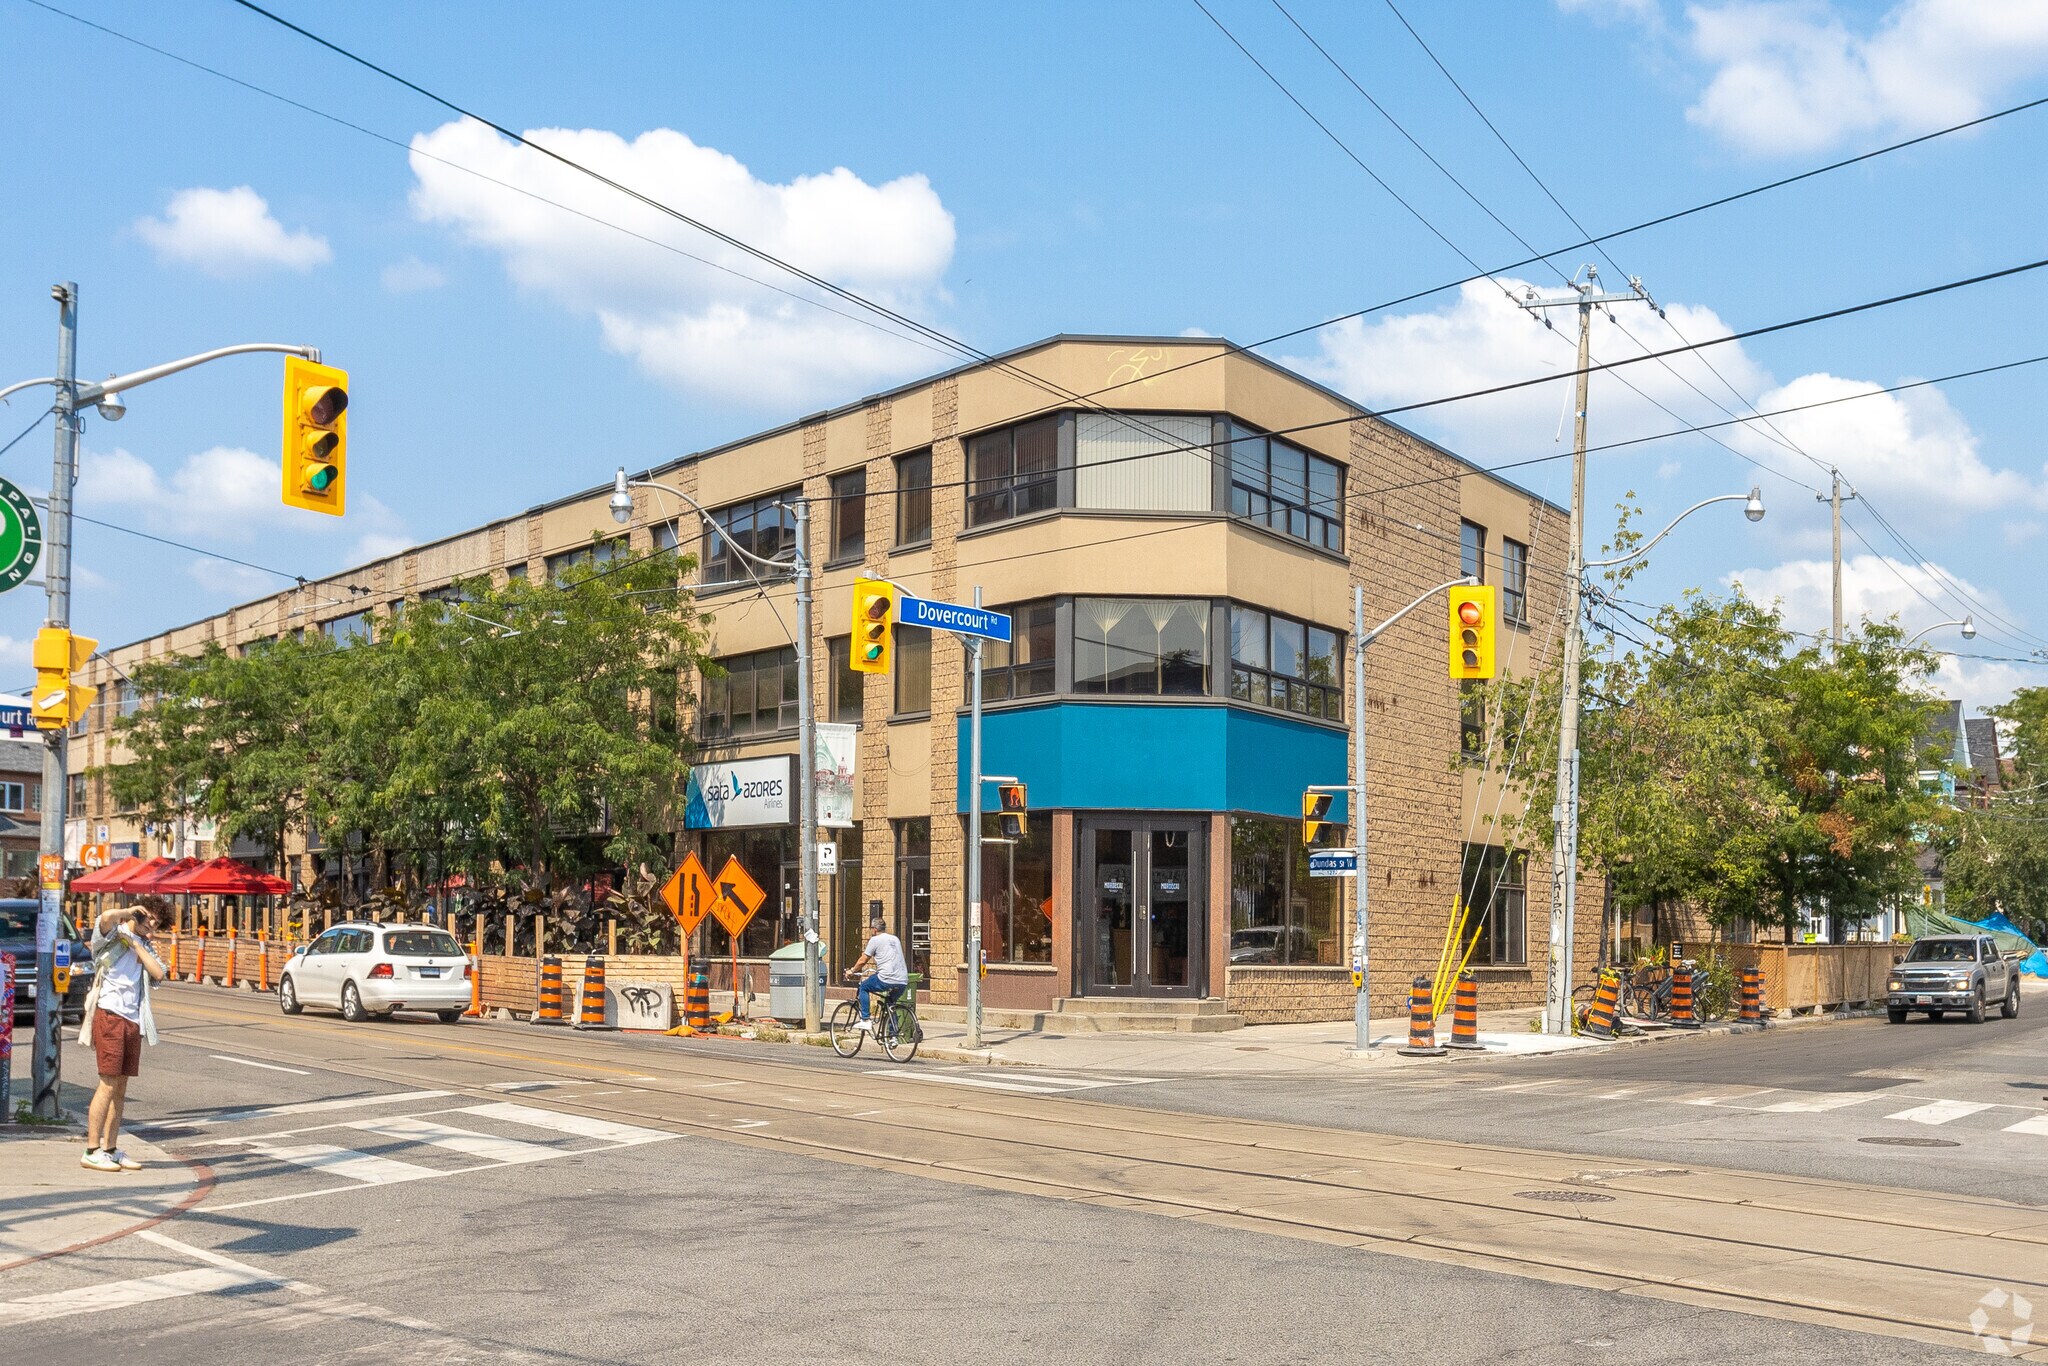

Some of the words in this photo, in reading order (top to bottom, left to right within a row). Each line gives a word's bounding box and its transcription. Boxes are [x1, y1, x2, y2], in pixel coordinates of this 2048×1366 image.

[918, 602, 988, 630] Dovercourt
[991, 616, 998, 625] Rd
[0, 710, 22, 725] urt
[708, 782, 729, 801] sata
[764, 799, 783, 809] Airlines
[44, 862, 61, 870] SALE
[1313, 859, 1337, 868] Dundas
[1347, 859, 1353, 867] W
